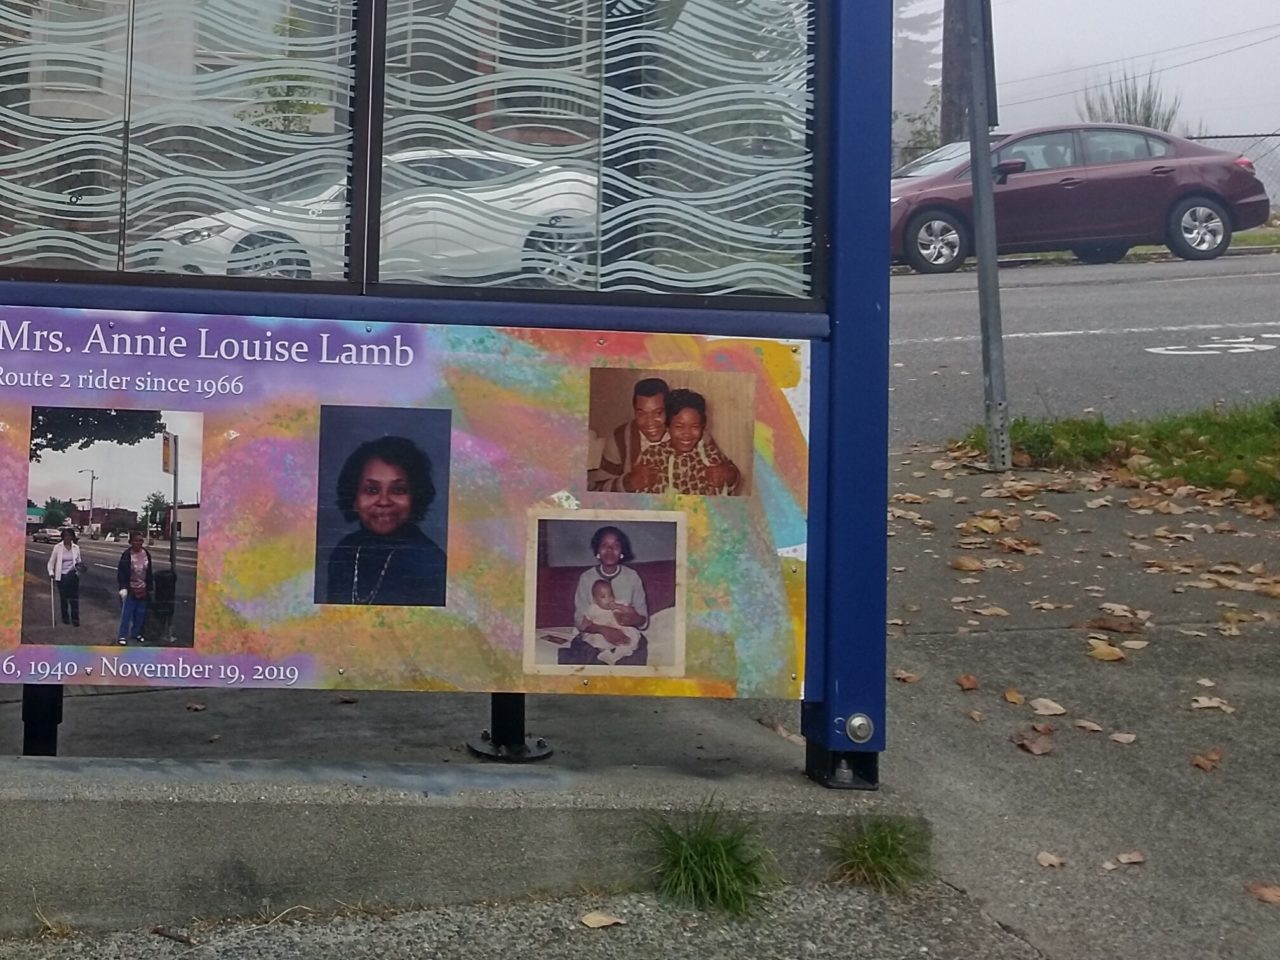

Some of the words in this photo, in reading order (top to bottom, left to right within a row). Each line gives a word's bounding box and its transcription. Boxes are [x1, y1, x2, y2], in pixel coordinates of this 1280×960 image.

[82, 323, 187, 358] Annie
[197, 328, 309, 363] Louise
[319, 333, 414, 367] Lamb
[59, 376, 71, 388] 2
[78, 368, 130, 390] rider
[135, 371, 190, 393] since
[195, 374, 244, 399] 1966
[2, 655, 21, 678] 6,
[29, 661, 78, 681] 1940
[100, 656, 213, 679] November
[219, 664, 245, 683] 19,
[252, 665, 299, 686] 2019
